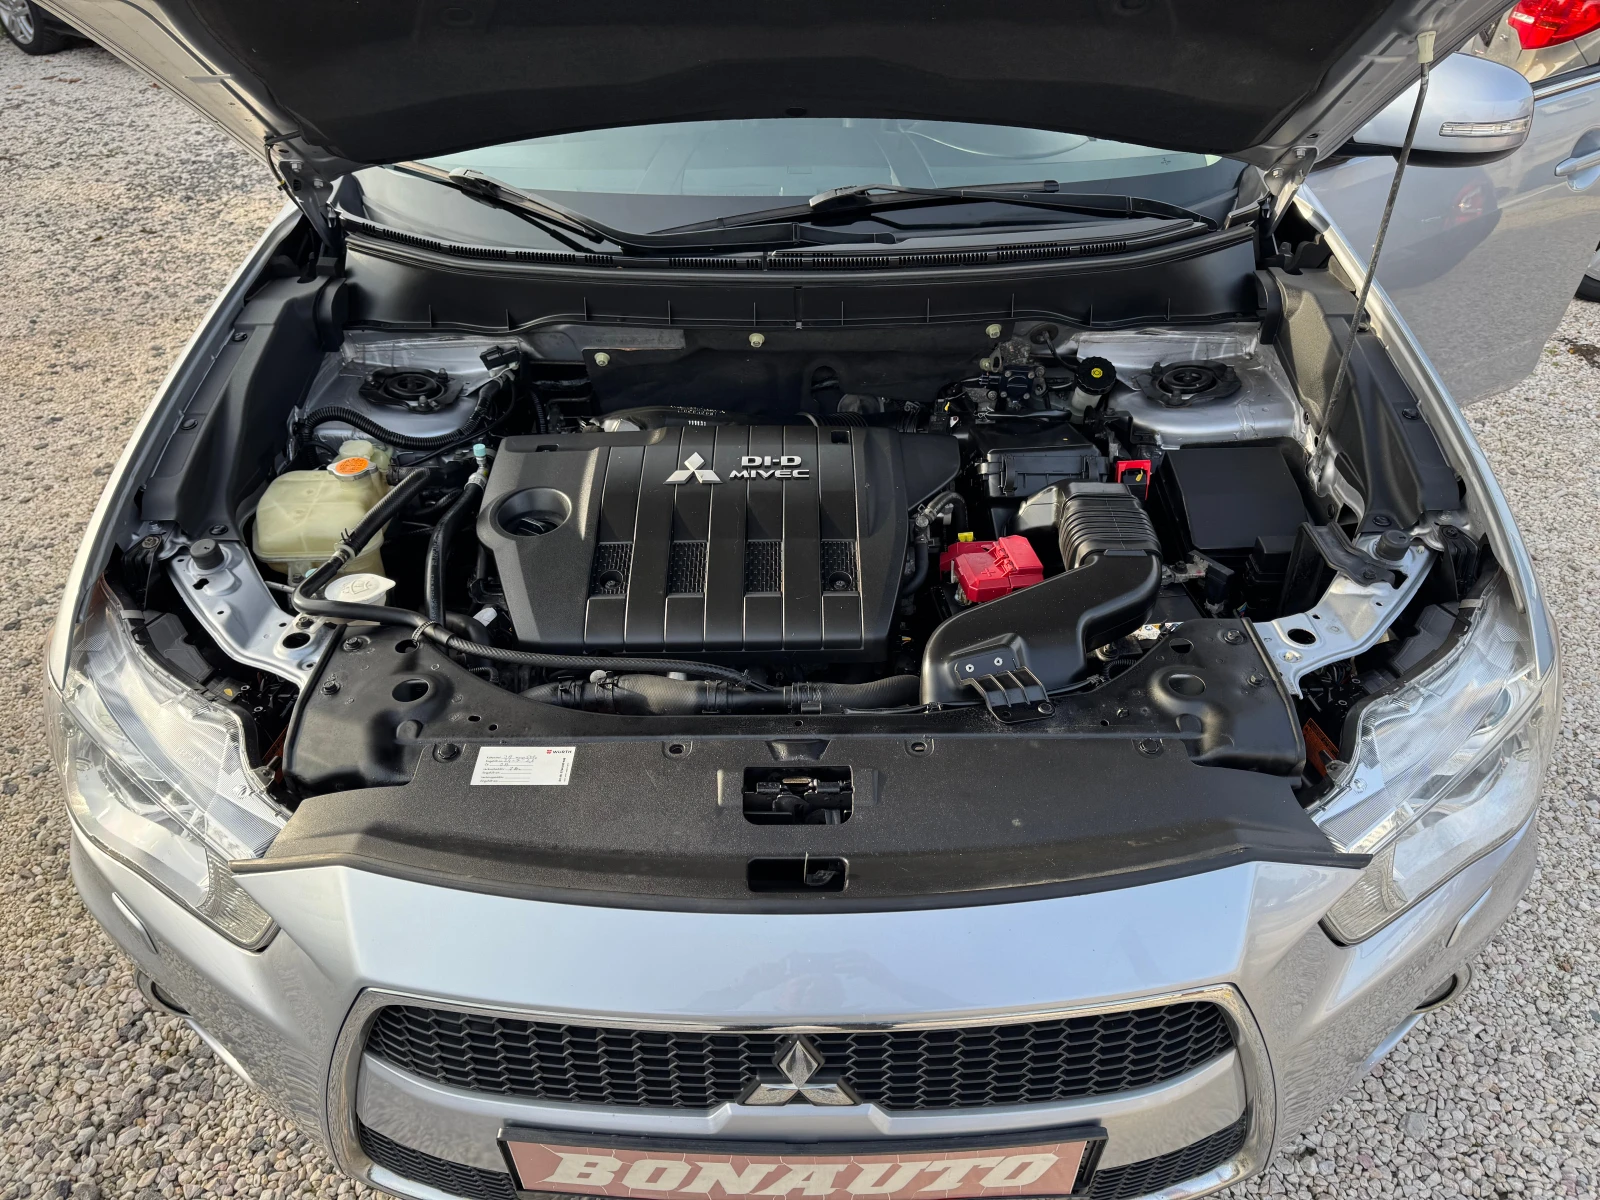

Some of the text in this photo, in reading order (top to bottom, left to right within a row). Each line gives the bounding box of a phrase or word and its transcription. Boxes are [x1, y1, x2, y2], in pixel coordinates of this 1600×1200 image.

[741, 455, 802, 468] DI-D
[729, 469, 810, 480] MIVEC
[541, 1152, 1060, 1196] BONAUTO
